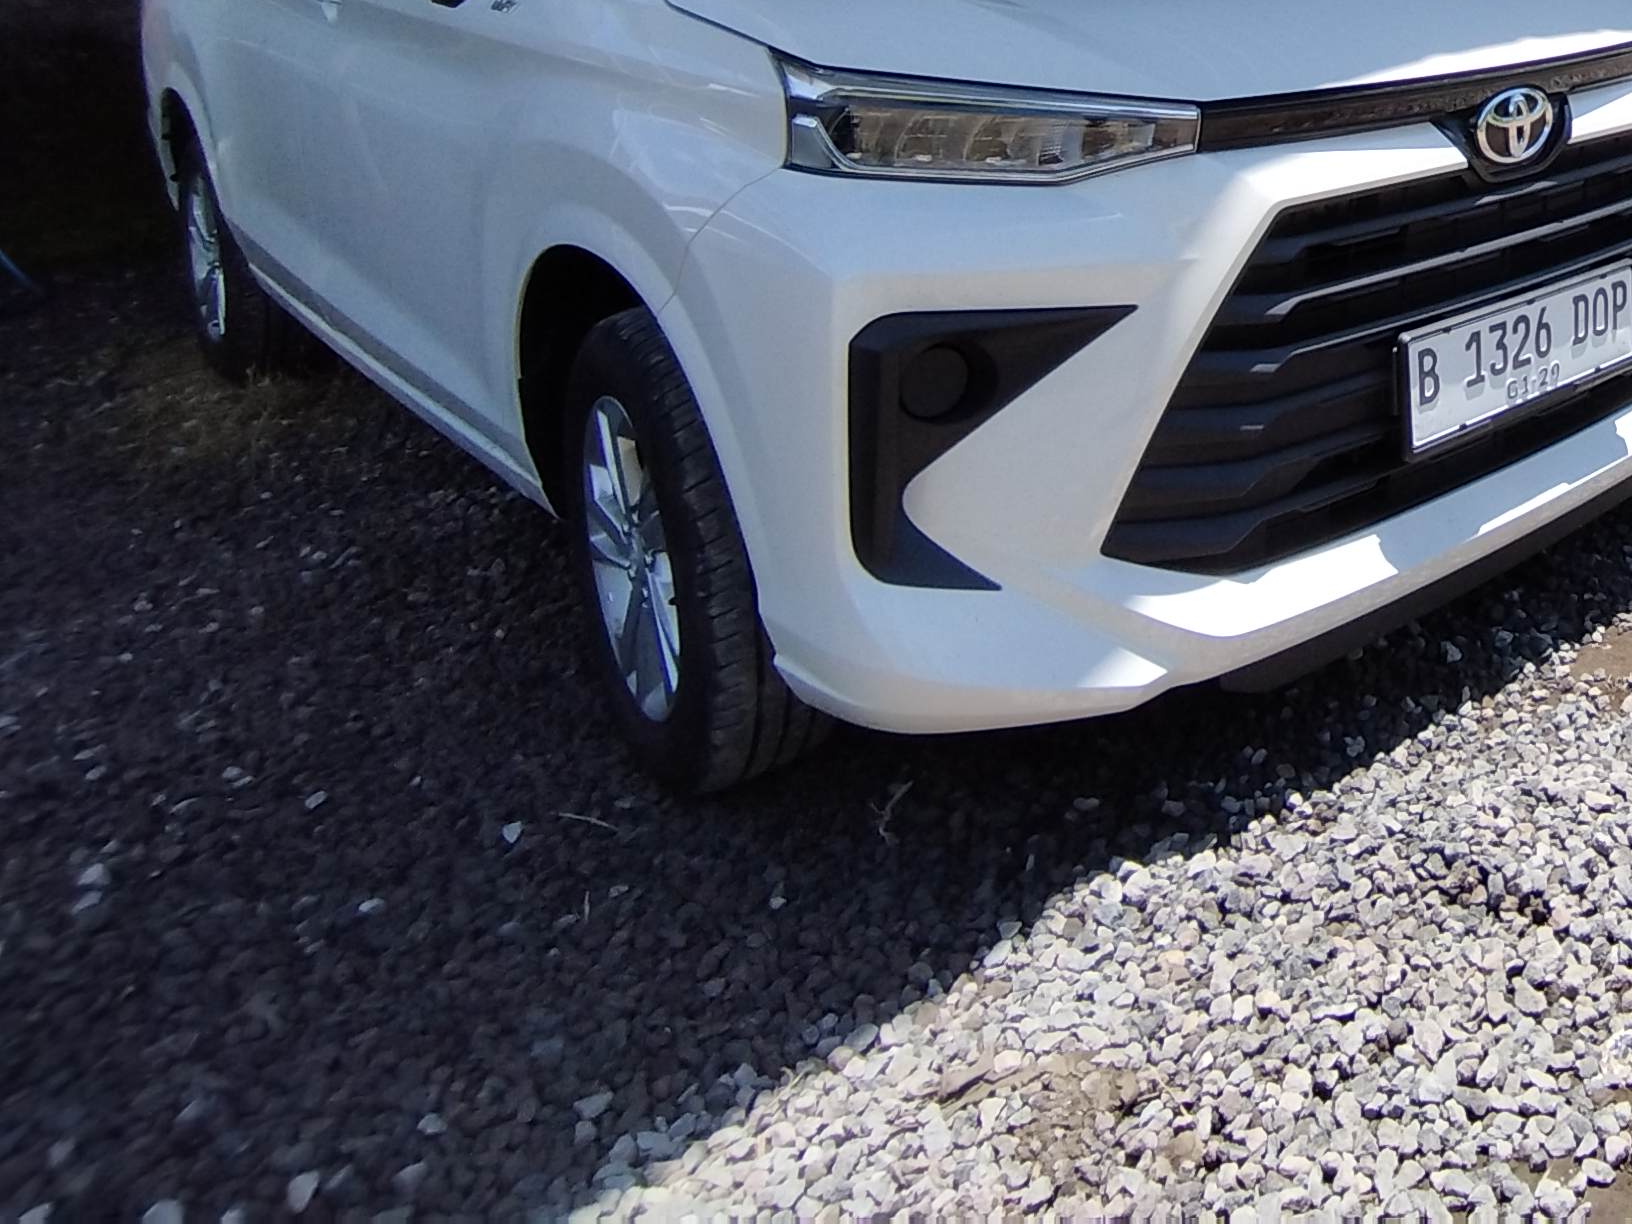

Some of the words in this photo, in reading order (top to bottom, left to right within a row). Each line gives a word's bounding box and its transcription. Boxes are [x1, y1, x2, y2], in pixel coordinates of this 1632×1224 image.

[1417, 347, 1441, 407] B
[1464, 305, 1552, 389] 1326
[1571, 279, 1628, 346] DOP
